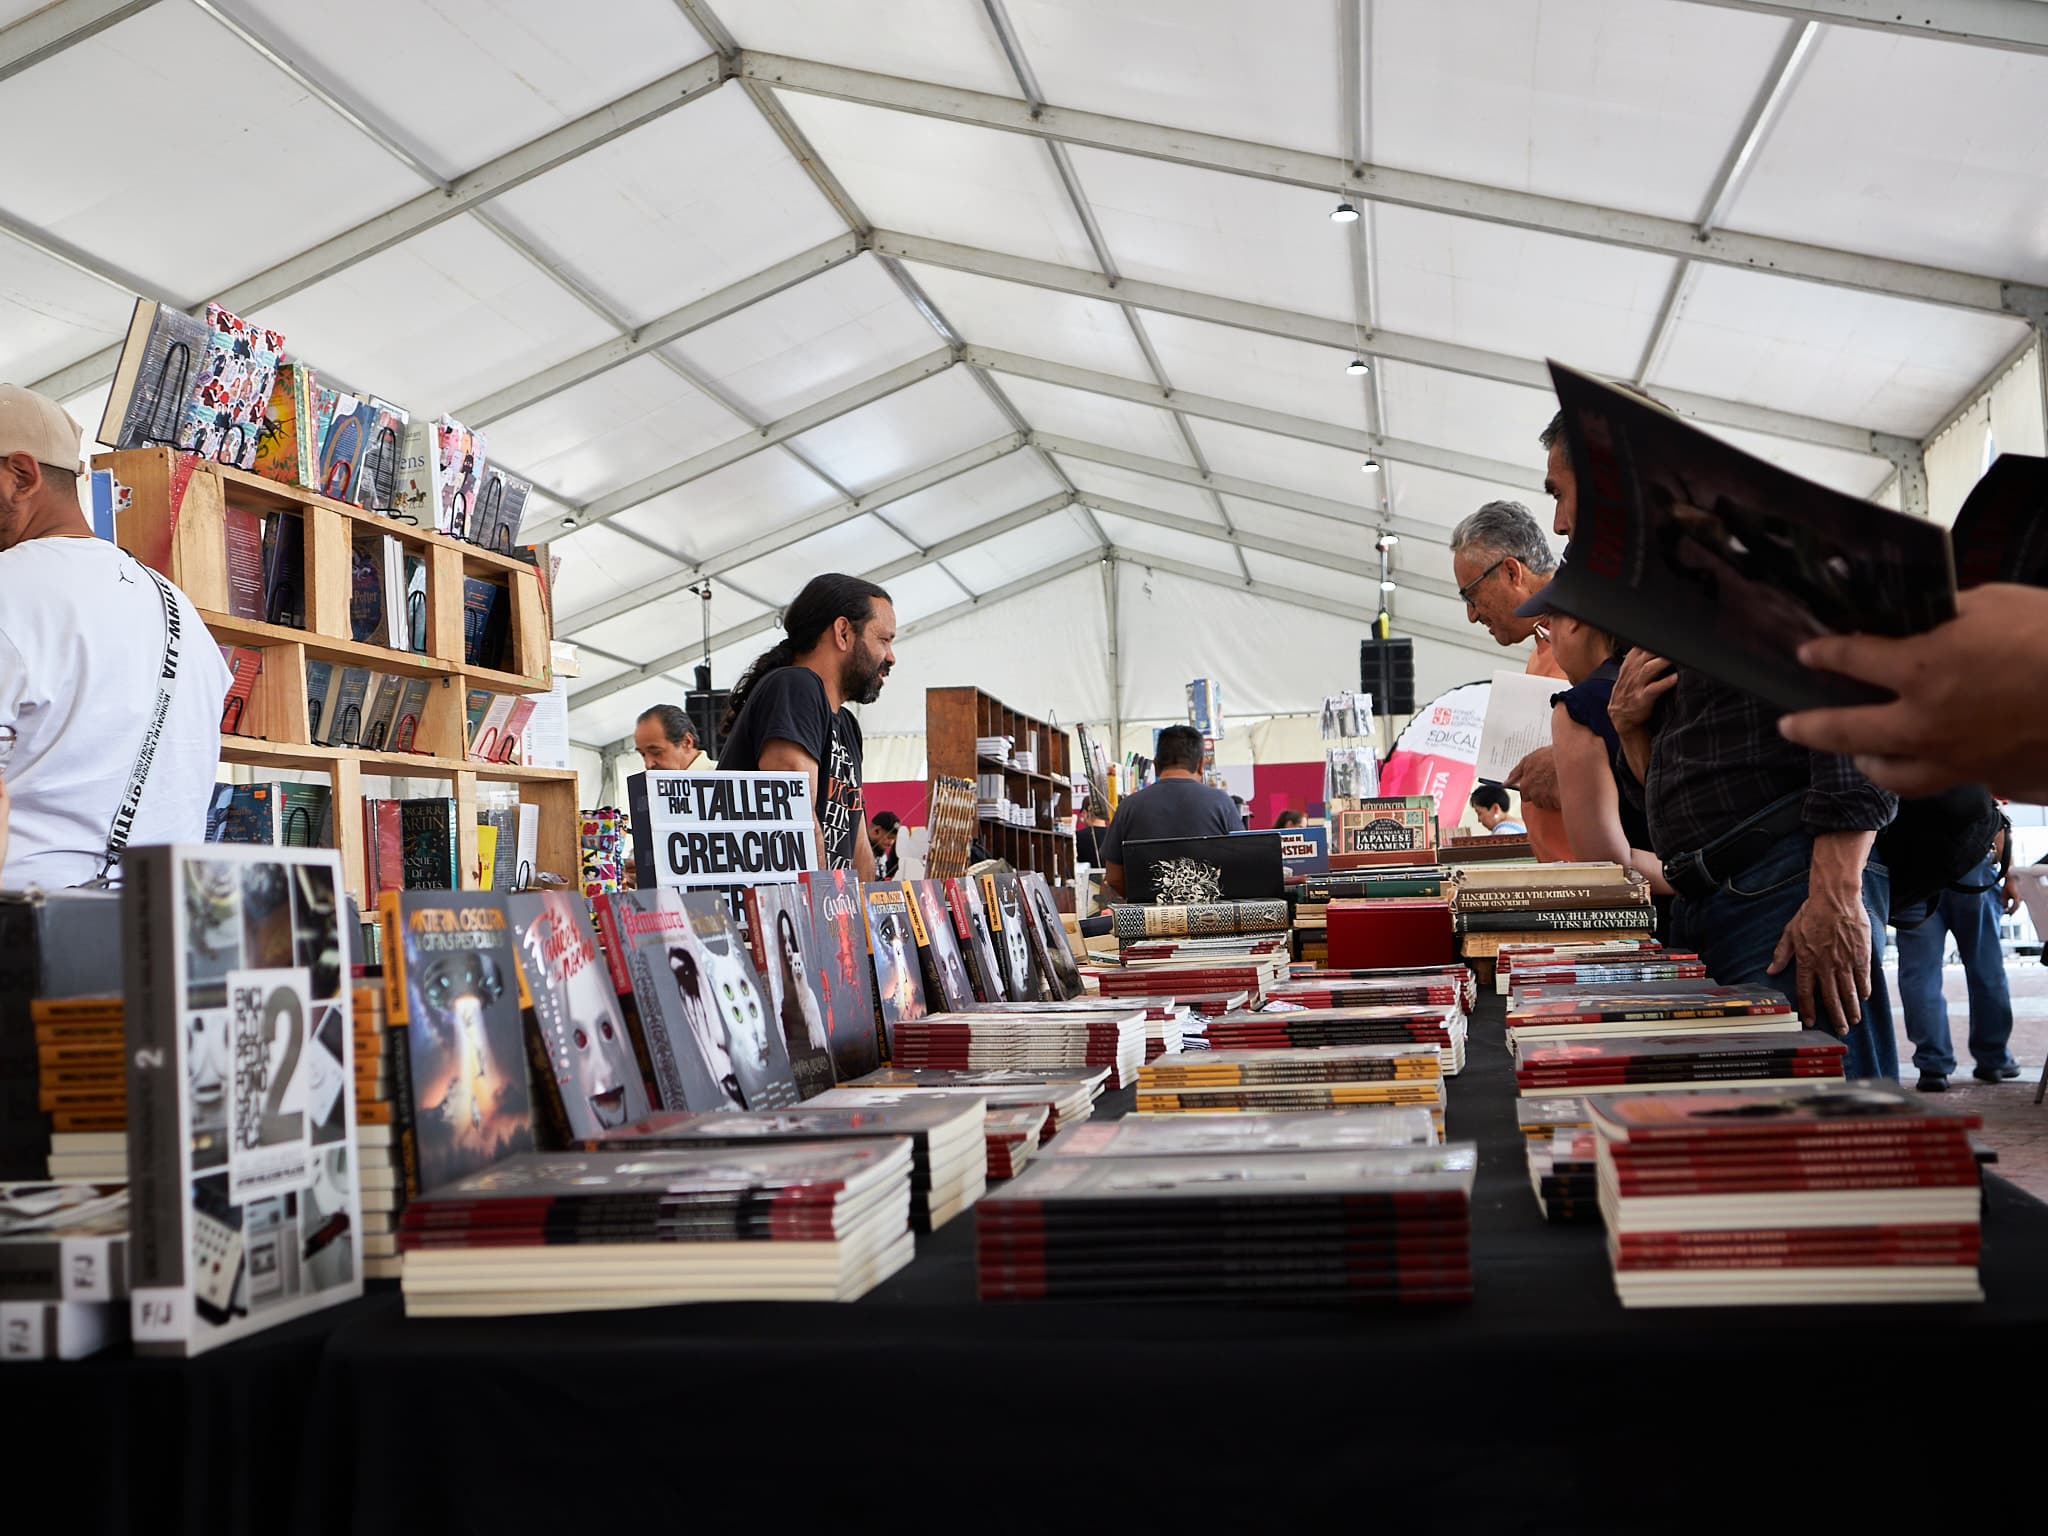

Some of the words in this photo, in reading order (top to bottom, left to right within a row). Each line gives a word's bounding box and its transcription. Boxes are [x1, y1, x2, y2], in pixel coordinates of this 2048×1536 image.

[656, 779, 691, 796] EDITO
[691, 779, 794, 821] TALLER
[790, 780, 805, 797] DE
[669, 797, 693, 814] RIAL
[403, 815, 445, 831] ARTIN
[1357, 834, 1411, 843] JAPANESE
[1357, 842, 1411, 851] ORNAMENT
[667, 830, 808, 875] CREACIÓN
[1536, 912, 1566, 921] WEST
[1567, 912, 1590, 921] THE
[1591, 911, 1603, 920] OF
[1604, 911, 1649, 920] WISDOM
[1551, 920, 1591, 929] RUSSELL
[1594, 919, 1649, 928] BERTRAND
[135, 1047, 163, 1068] 2
[263, 986, 304, 1146] 2
[143, 1303, 171, 1325] F/J
